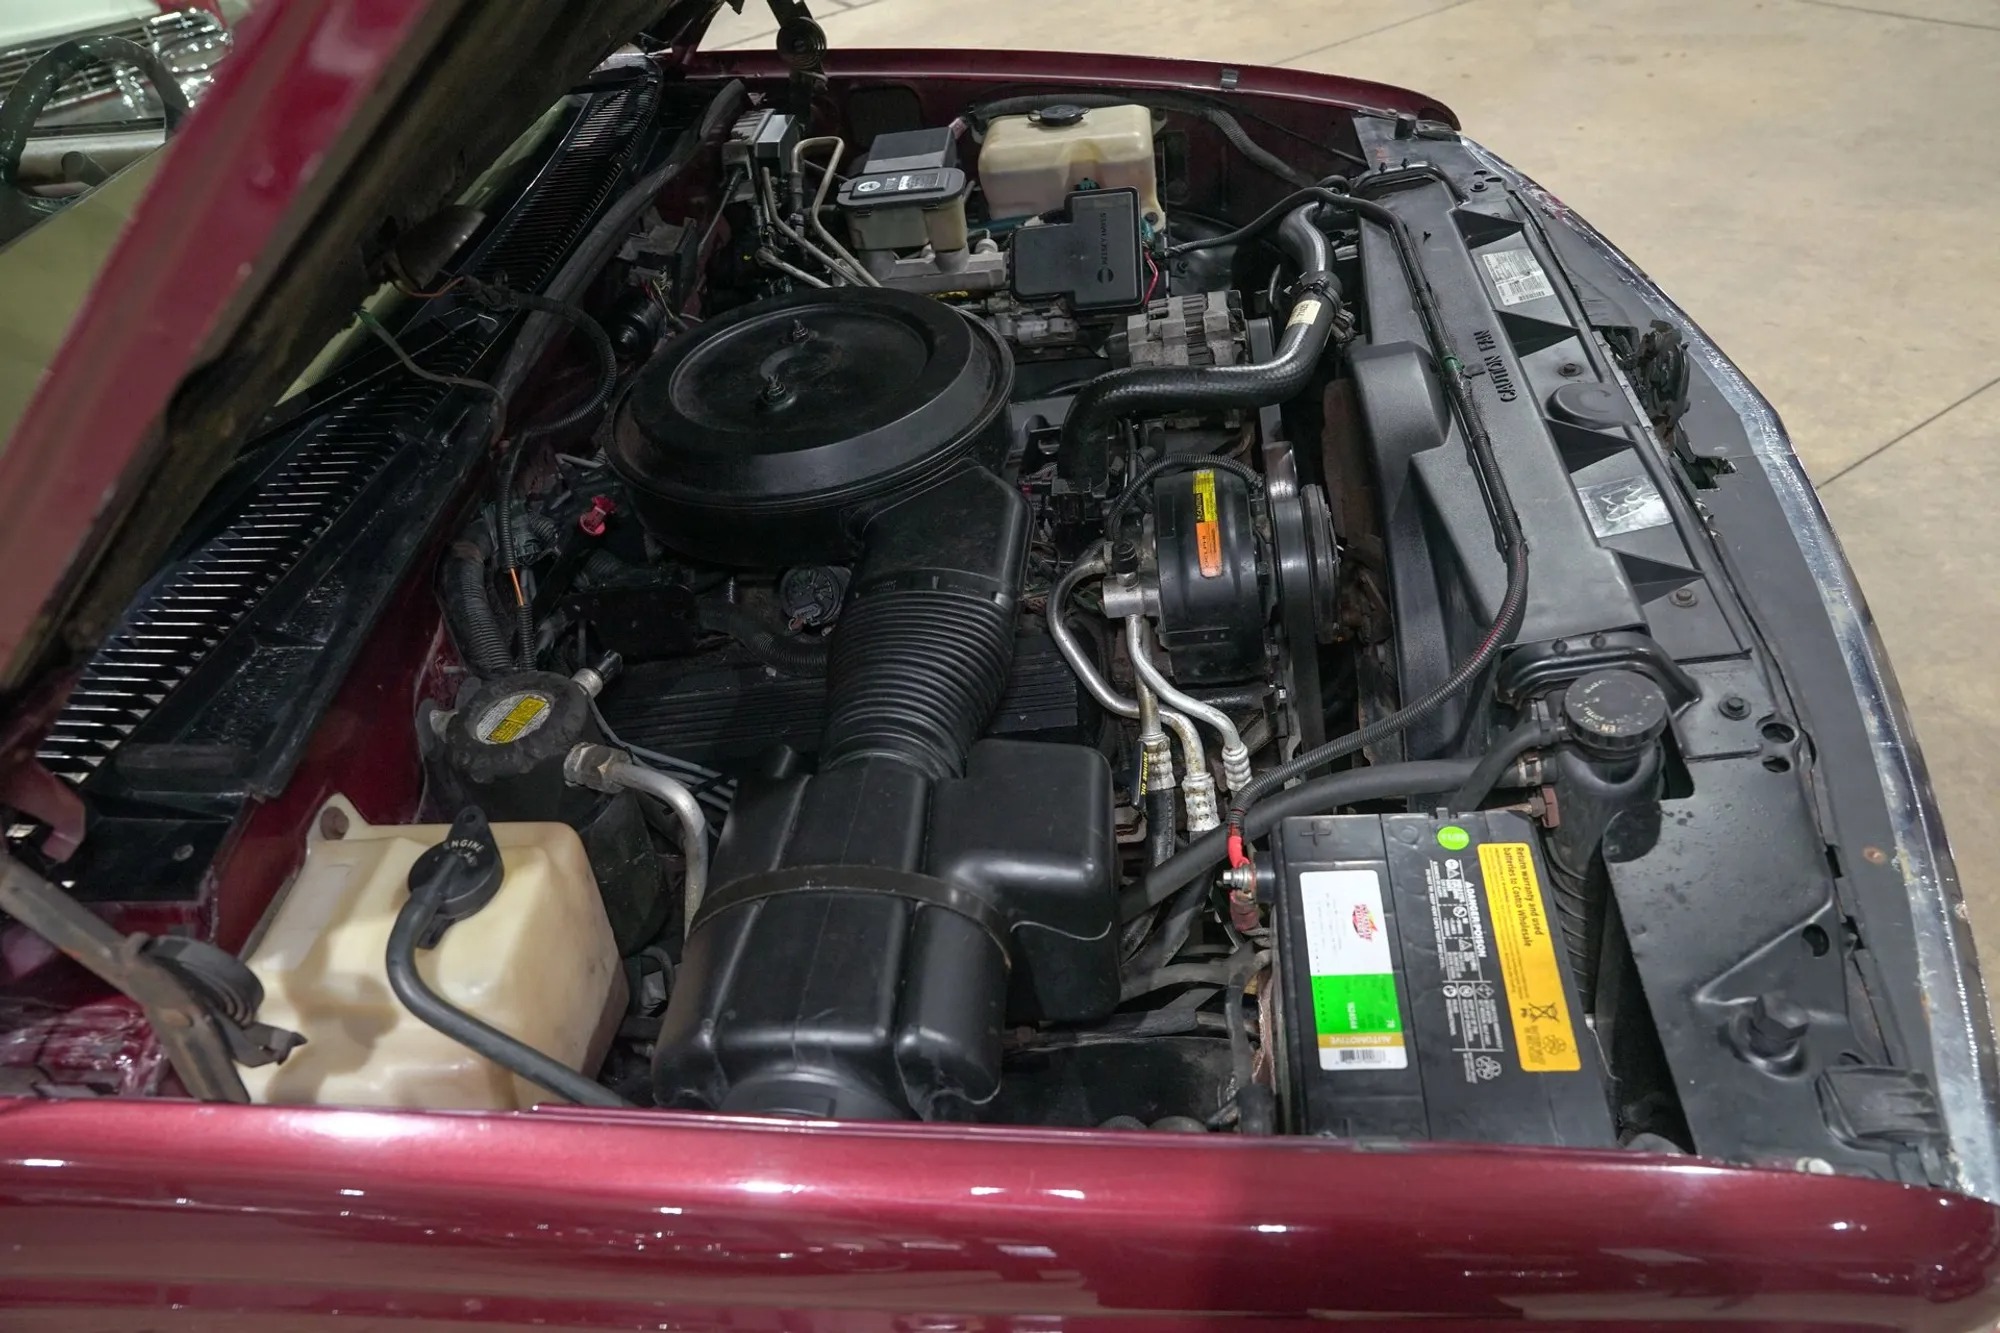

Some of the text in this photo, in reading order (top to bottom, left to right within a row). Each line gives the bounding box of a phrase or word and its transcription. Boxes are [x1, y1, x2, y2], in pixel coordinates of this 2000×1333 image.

[1473, 330, 1518, 402] CAUTION FAN
[1466, 888, 1487, 957] DANGER POISON
[1503, 847, 1516, 876] batteries
[1512, 887, 1522, 908] Costco
[1518, 909, 1531, 947] Wholesale
[1516, 847, 1544, 936] Return warranty and used
